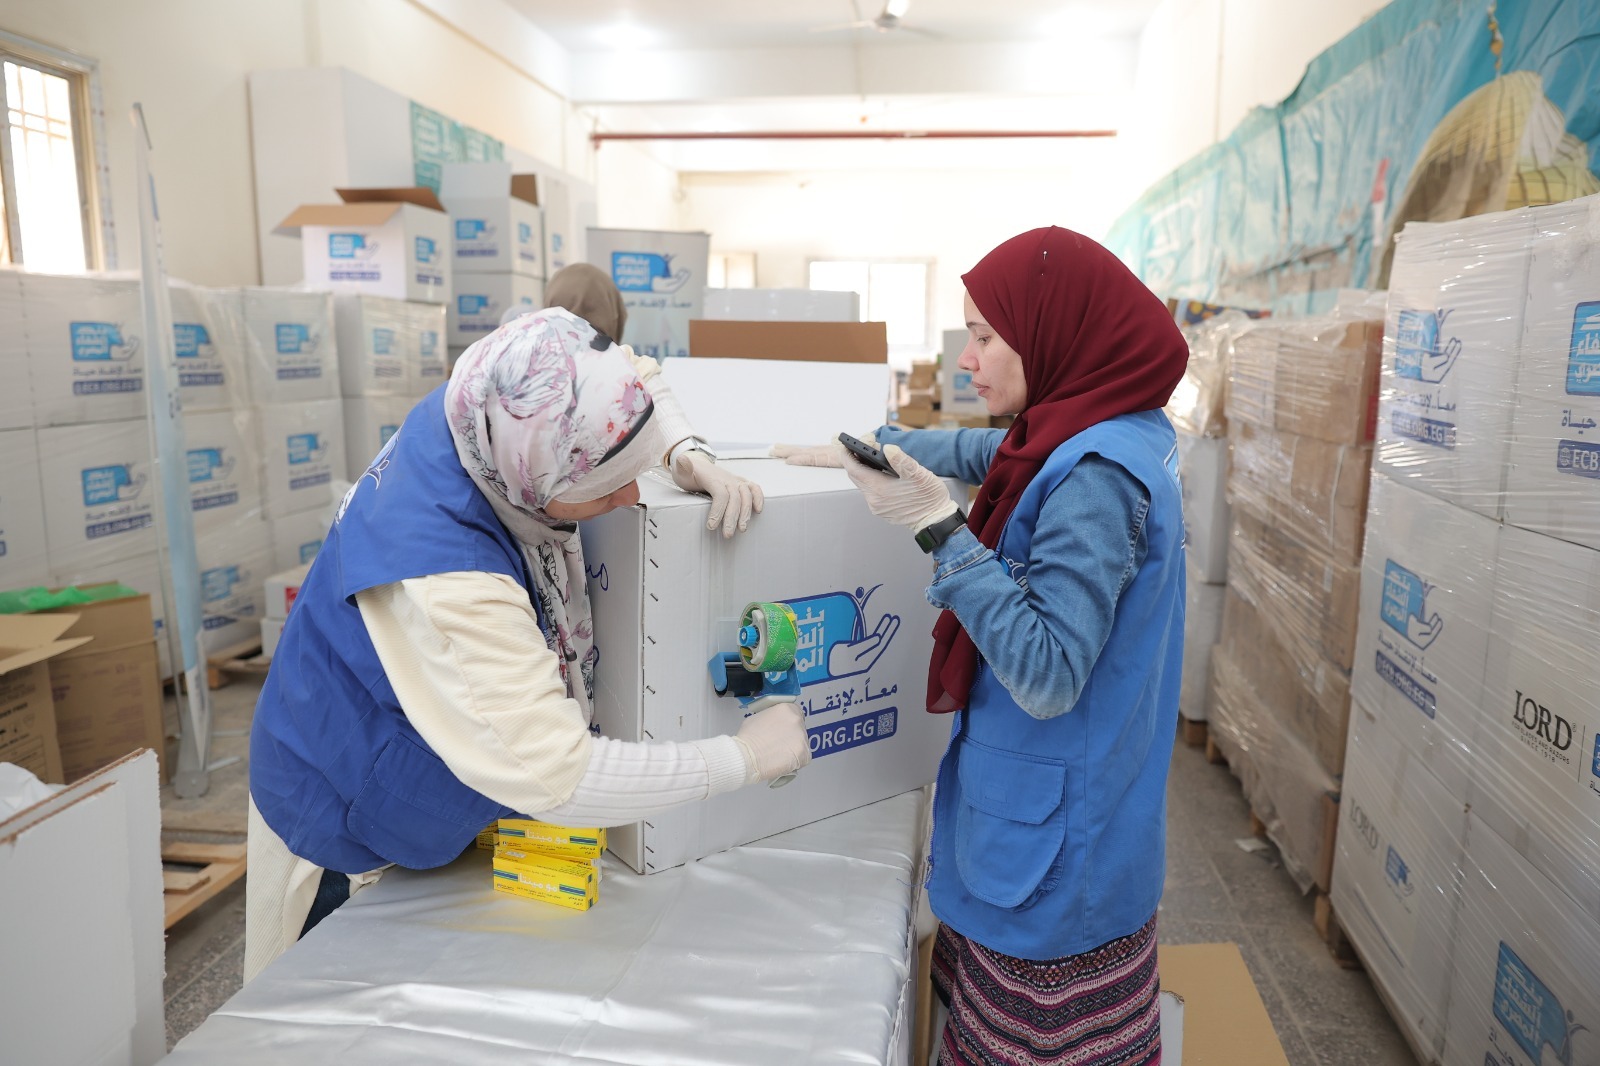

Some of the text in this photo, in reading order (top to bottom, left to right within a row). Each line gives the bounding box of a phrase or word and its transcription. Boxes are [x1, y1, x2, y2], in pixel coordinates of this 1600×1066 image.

[1561, 408, 1597, 435] حياة
[1573, 449, 1599, 471] ECB
[796, 606, 825, 625] بن
[1513, 689, 1573, 751] LORD
[808, 718, 875, 754] ORG.EG
[1549, 747, 1570, 765] RAZORS
